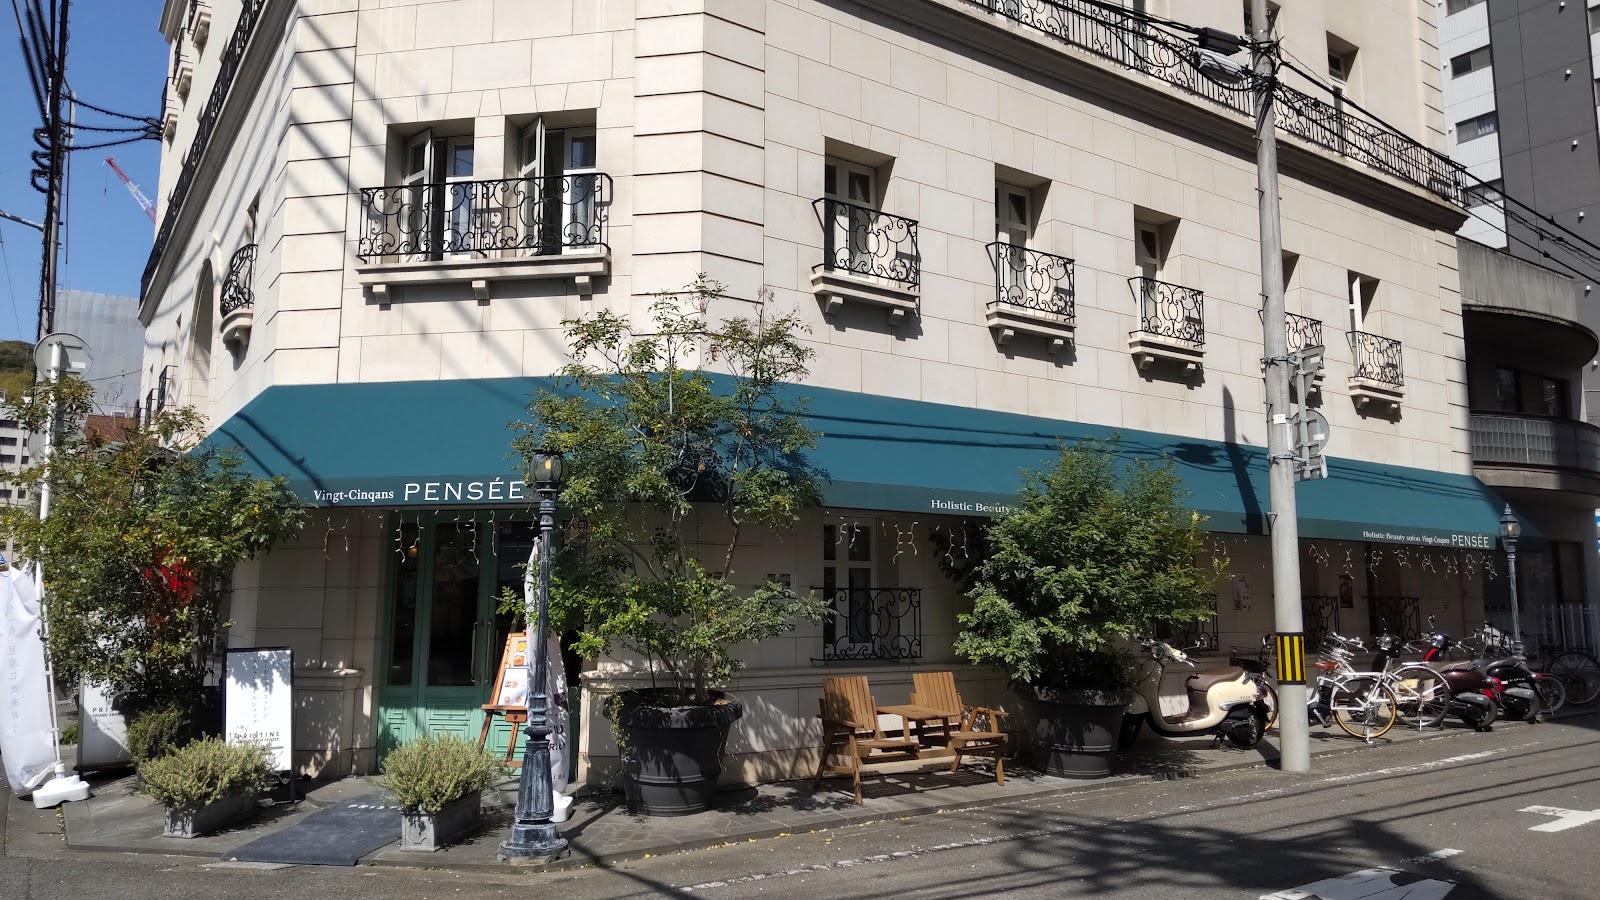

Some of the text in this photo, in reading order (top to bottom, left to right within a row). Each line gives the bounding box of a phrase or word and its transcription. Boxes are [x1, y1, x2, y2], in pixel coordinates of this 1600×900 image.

[313, 477, 524, 504] Vingt-Cinqans PENSÉE
[931, 499, 973, 511] Holistic
[975, 502, 1011, 515] Beauty
[1363, 530, 1385, 540] Holistic
[1386, 532, 1405, 542] Beauty
[1451, 533, 1490, 548] PENSÉE
